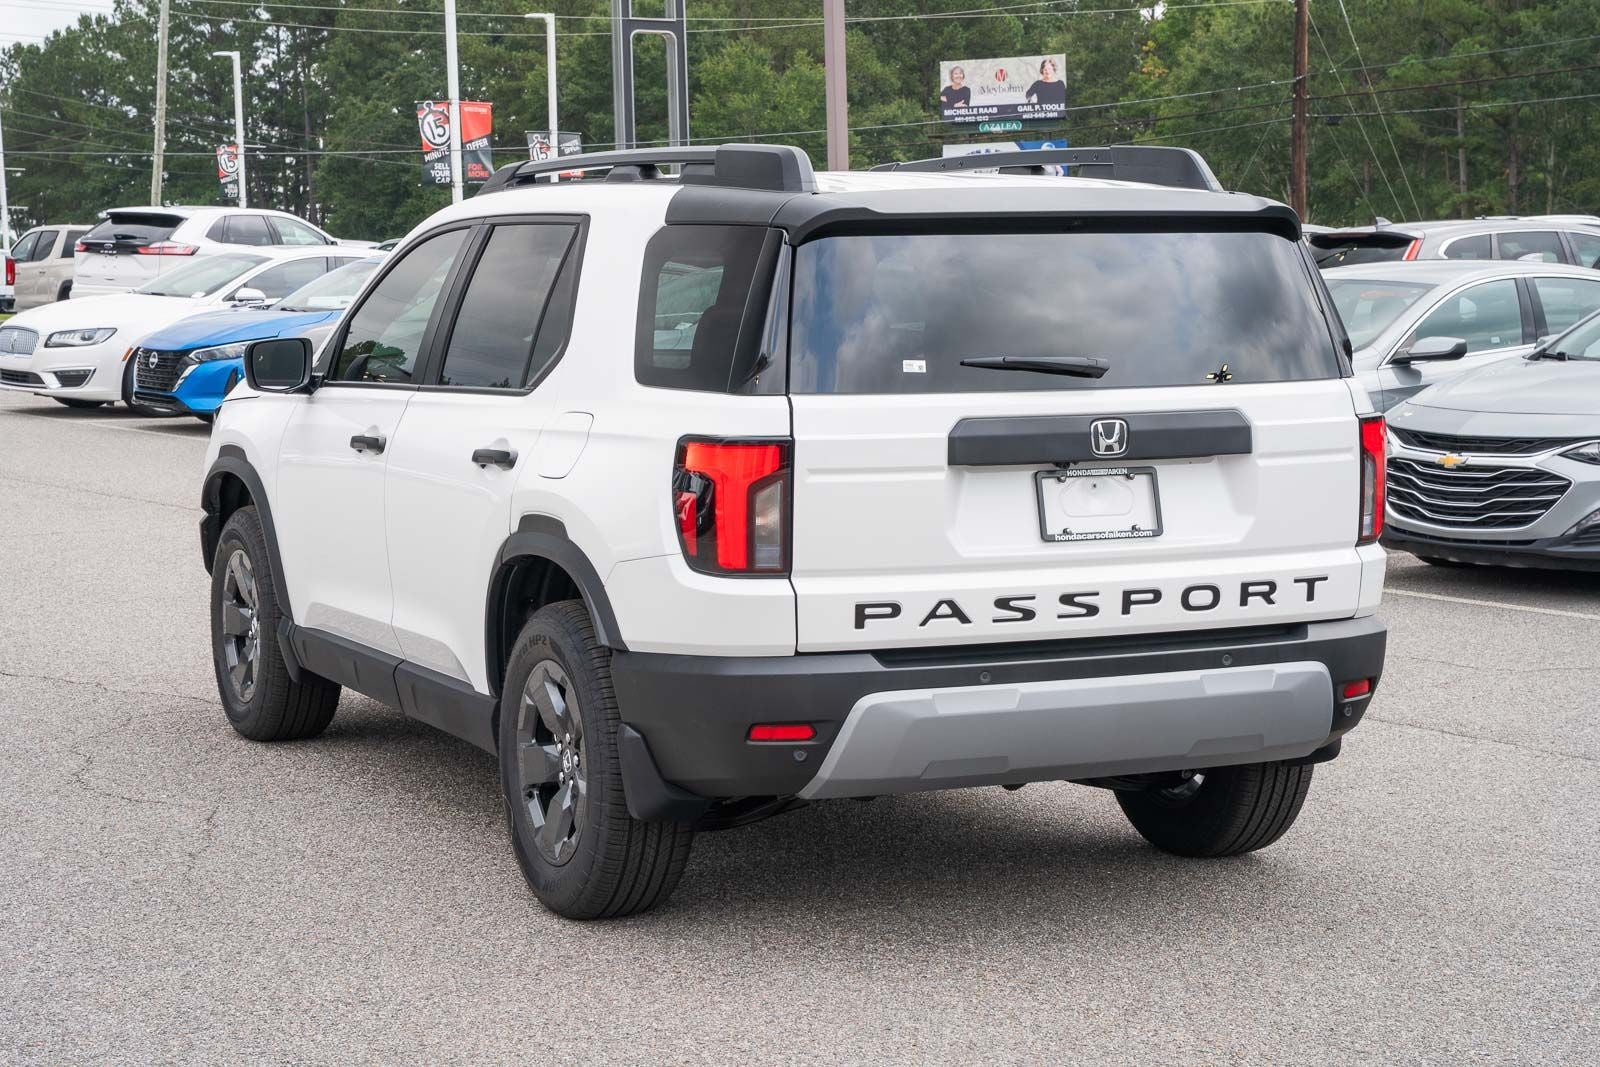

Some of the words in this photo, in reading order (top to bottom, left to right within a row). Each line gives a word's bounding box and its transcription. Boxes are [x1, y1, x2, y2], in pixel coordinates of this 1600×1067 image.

[978, 106, 998, 114] RAAB
[1042, 103, 1065, 111] TOOLE
[427, 116, 447, 140] 15
[984, 121, 1018, 131] AZALEA
[466, 137, 489, 151] OFFER
[424, 146, 450, 162] MINUTE
[223, 155, 236, 170] 15
[434, 162, 450, 170] SELL
[467, 163, 483, 171] FOR
[467, 170, 489, 178] MORE
[435, 176, 451, 184] CAR
[1066, 469, 1092, 477] HONDA
[1107, 467, 1128, 476] AIKEN
[1055, 531, 1152, 541] hondacarsofaiken.com
[853, 575, 1329, 630] PASSPORT
